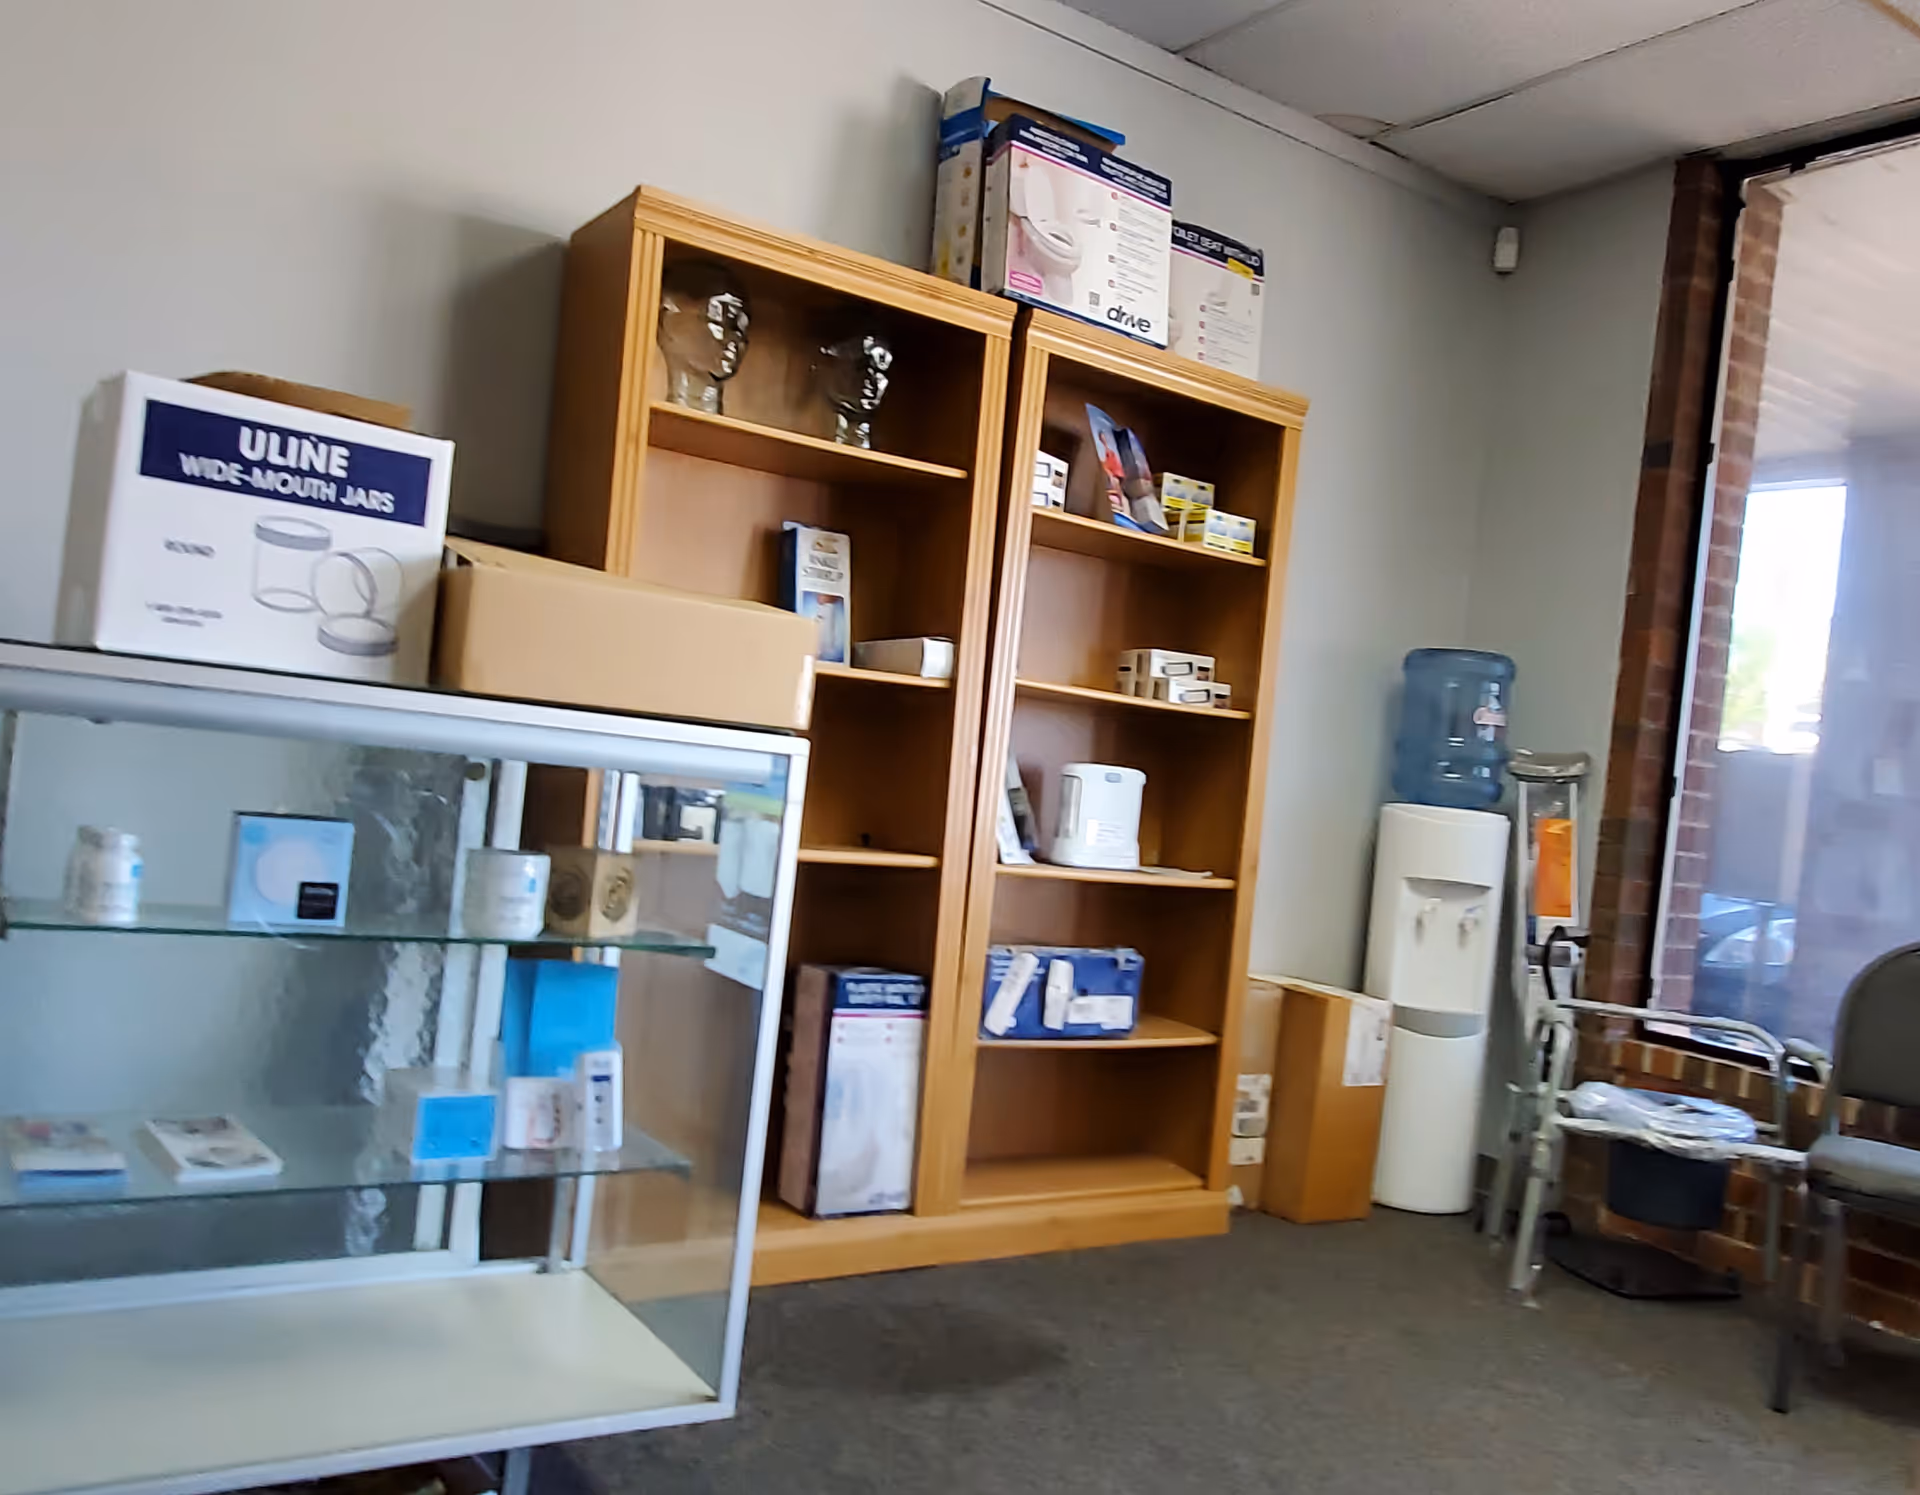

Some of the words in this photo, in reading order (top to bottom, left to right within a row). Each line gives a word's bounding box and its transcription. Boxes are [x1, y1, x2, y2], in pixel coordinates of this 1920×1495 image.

[1173, 226, 1199, 243] OILET
[1107, 304, 1151, 333] drive
[239, 426, 350, 479] ULINE
[178, 452, 337, 503] WIDE-MOUTH
[340, 487, 395, 514] JARS
